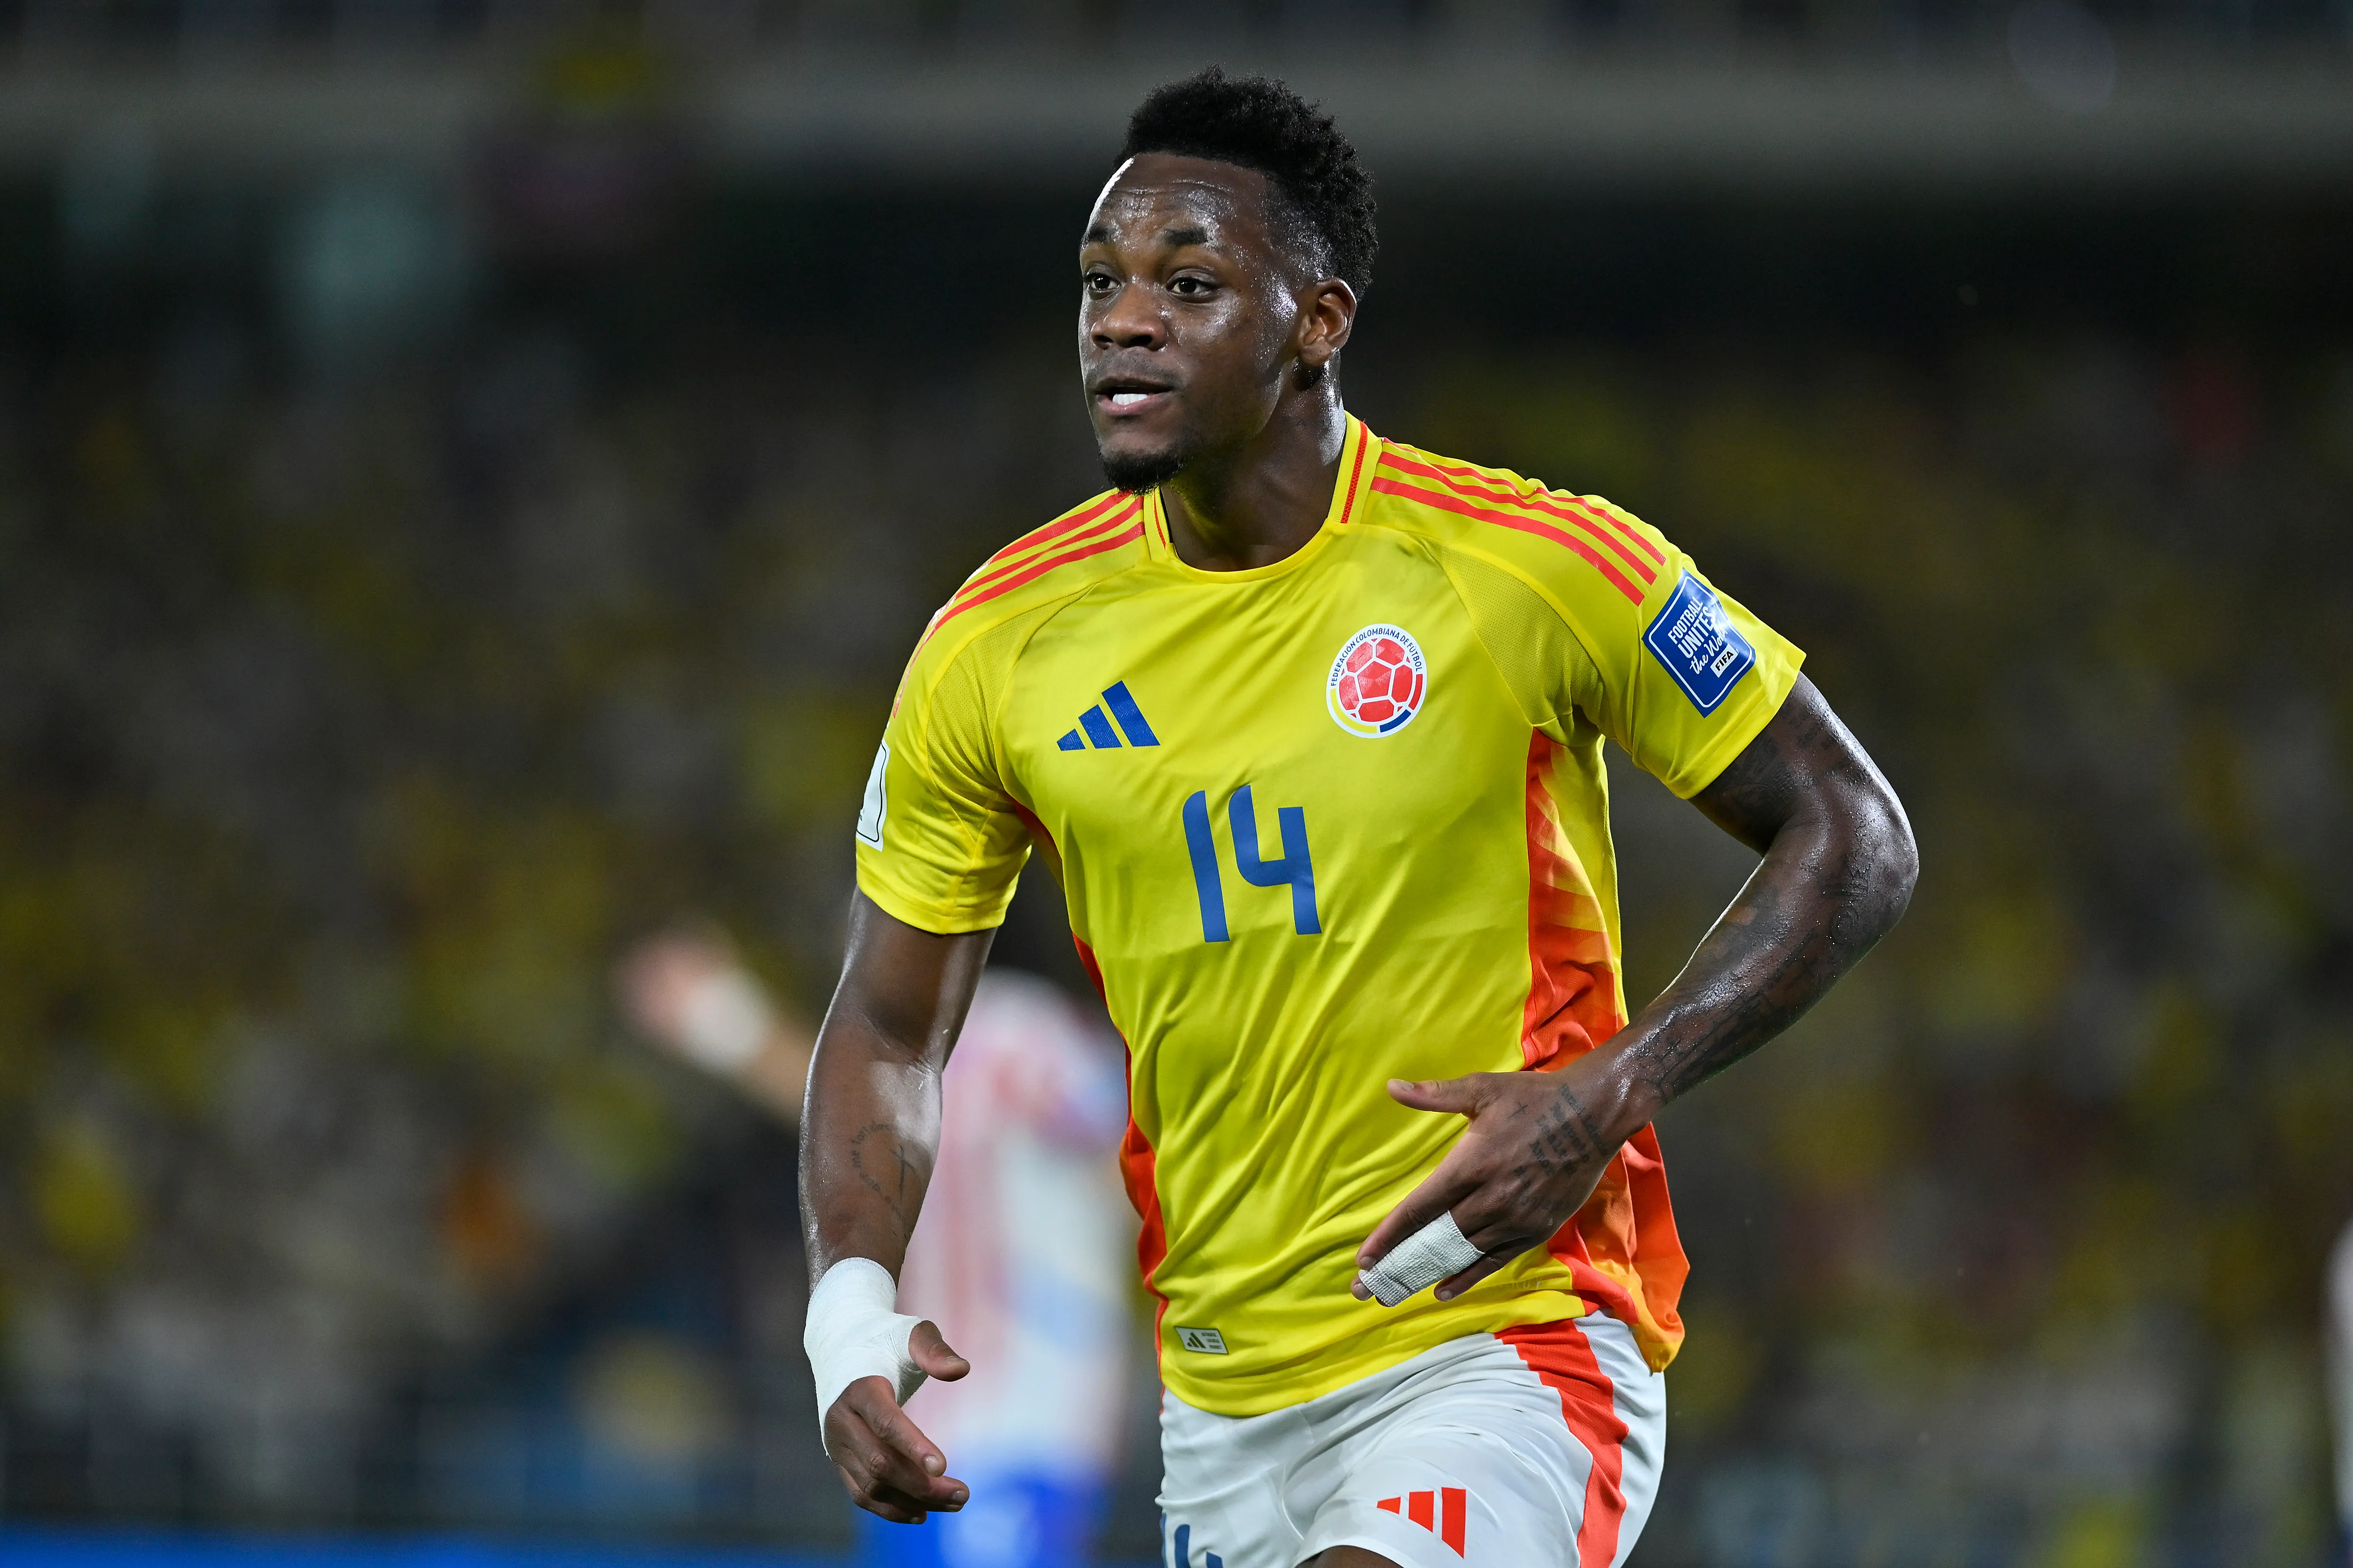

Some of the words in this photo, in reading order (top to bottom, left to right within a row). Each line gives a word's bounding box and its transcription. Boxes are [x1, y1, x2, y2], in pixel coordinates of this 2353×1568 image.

[1668, 596, 1703, 644] FOOTBALL
[1678, 607, 1716, 658] UNITES
[1331, 641, 1356, 686] FEDERACIÓN
[1355, 628, 1400, 643] COLOMBIANA
[1399, 635, 1409, 645] DE
[1406, 643, 1423, 672] FÚTBOL
[1689, 654, 1709, 675] the
[1715, 651, 1734, 672] FIFA
[1182, 784, 1322, 942] 14
